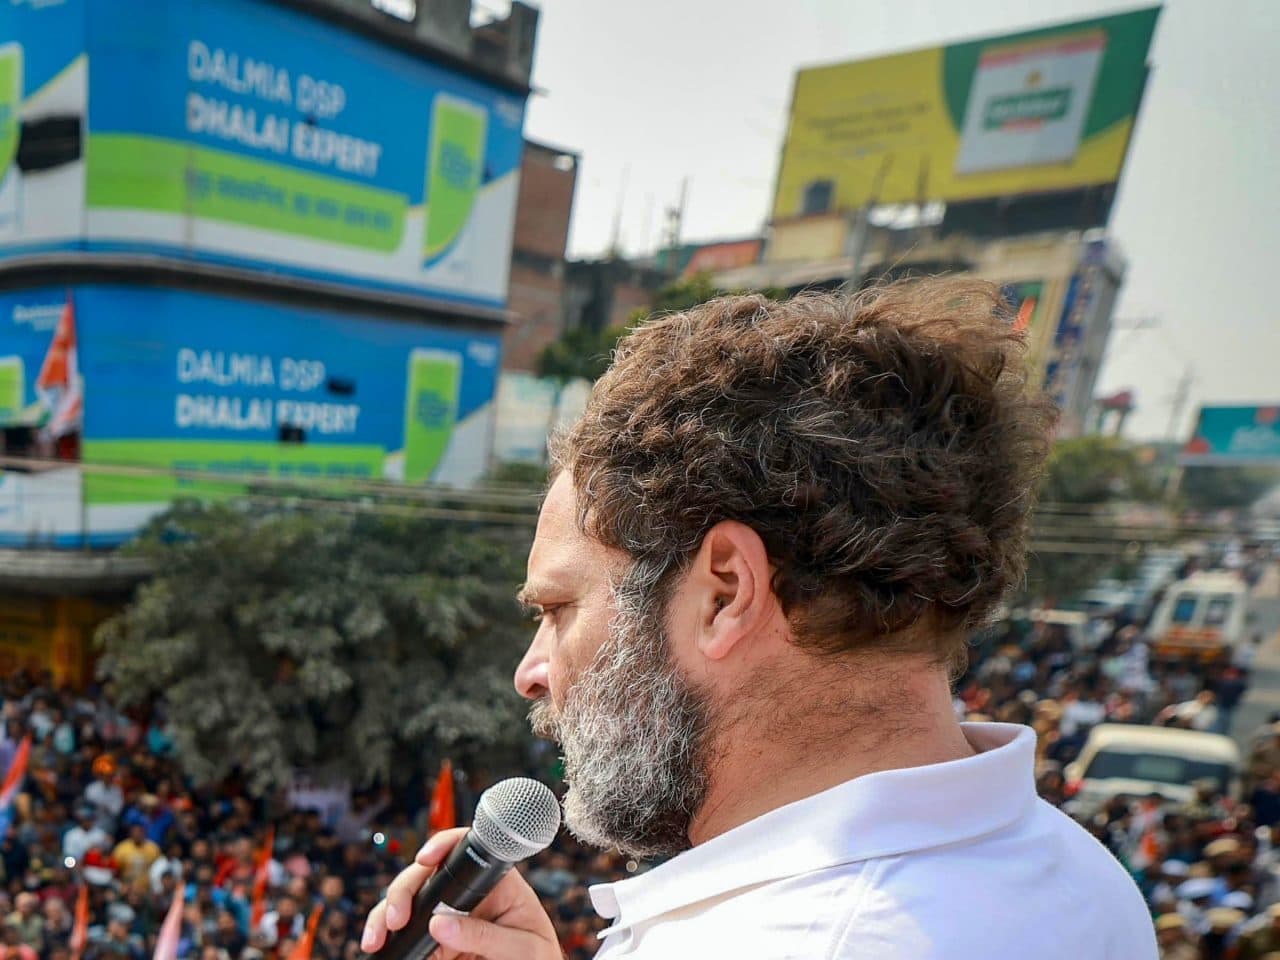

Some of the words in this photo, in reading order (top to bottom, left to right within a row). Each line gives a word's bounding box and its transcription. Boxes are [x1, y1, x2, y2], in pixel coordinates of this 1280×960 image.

[188, 39, 292, 104] DALMIA
[296, 74, 347, 120] DSP
[186, 91, 290, 154] DHALAI
[291, 121, 383, 178] EXPERT
[177, 348, 275, 387] DALMIA
[279, 357, 326, 392] DSP
[176, 394, 273, 430] DHALAI
[276, 398, 360, 434] EXPERT
